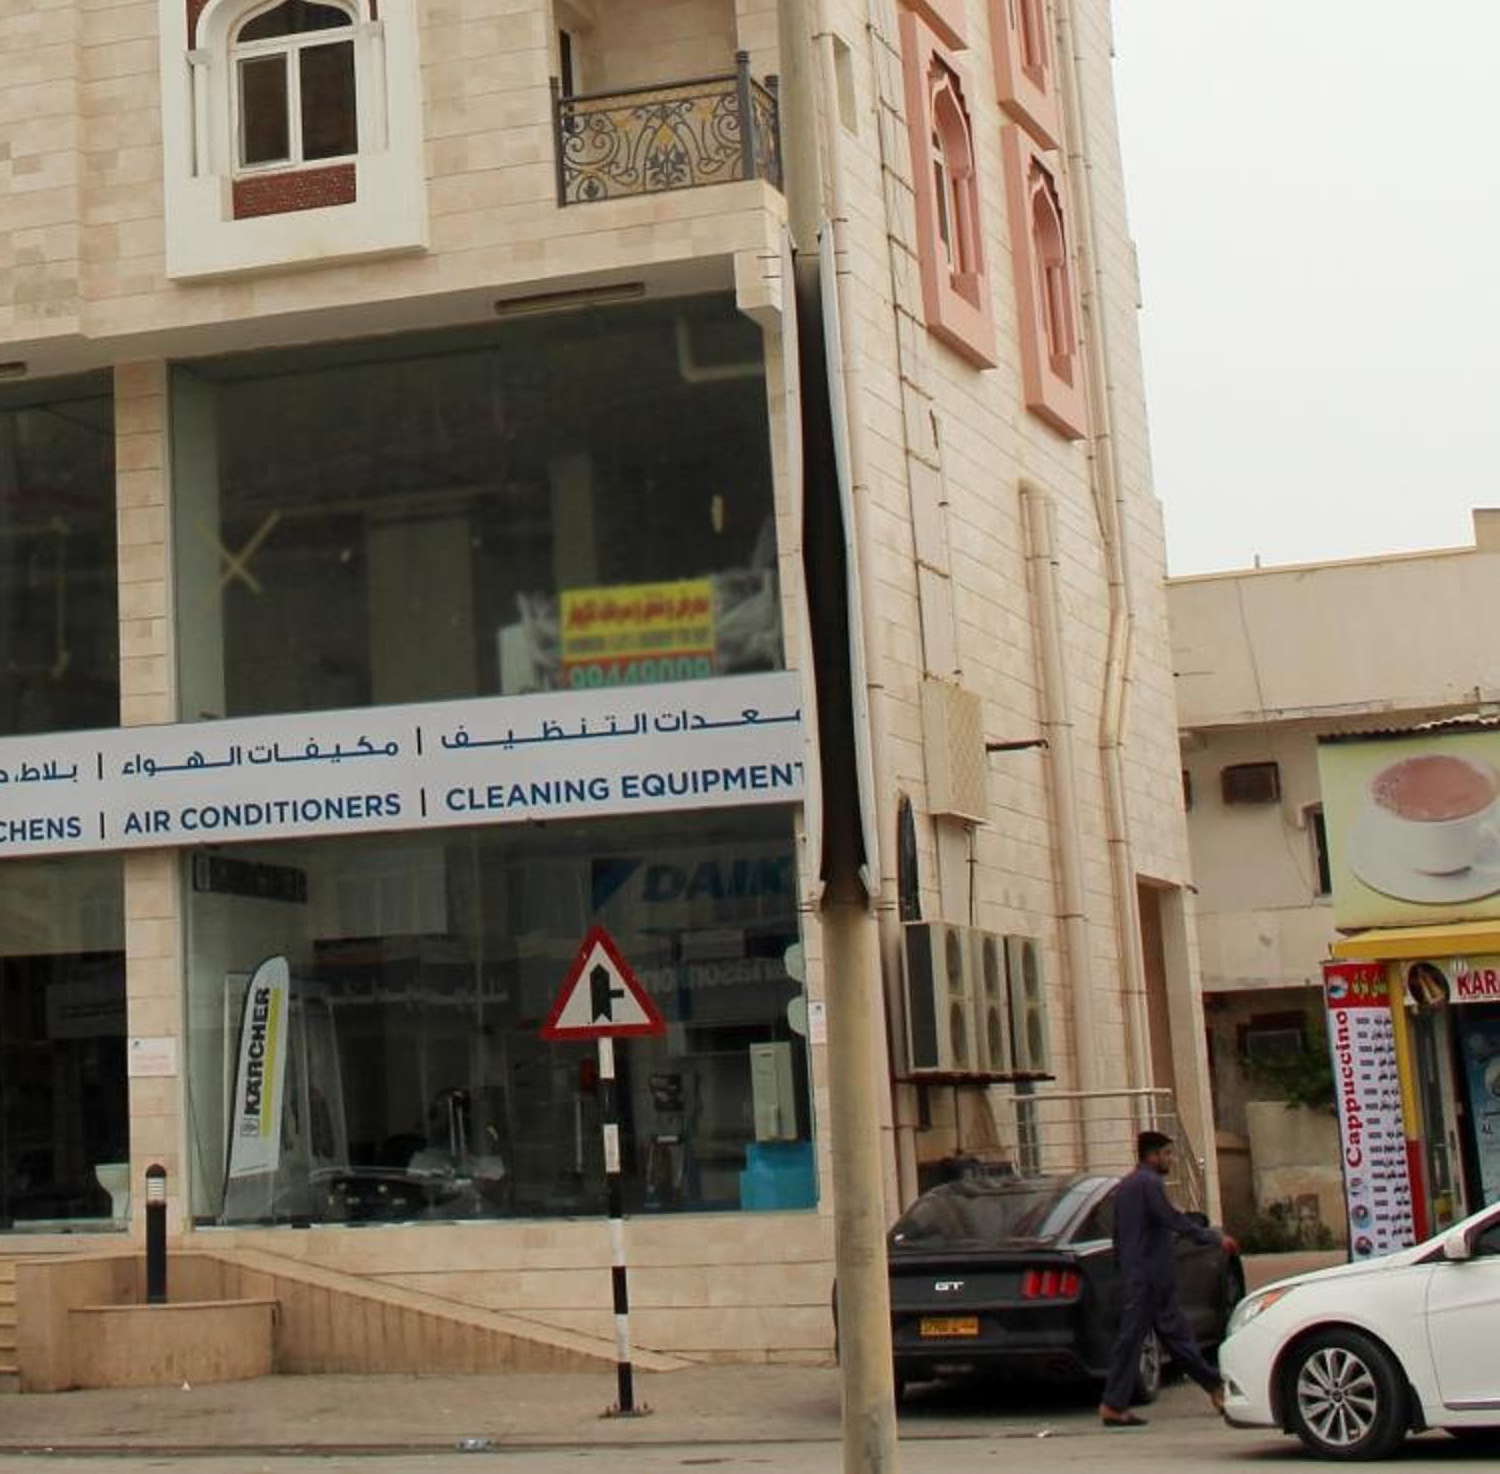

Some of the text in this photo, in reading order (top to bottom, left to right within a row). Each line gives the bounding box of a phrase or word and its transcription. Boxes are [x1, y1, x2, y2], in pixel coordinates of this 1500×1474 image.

[442, 712, 648, 750] التنظيف
[122, 736, 399, 776] مكيفات الهواء
[124, 793, 401, 834] AIR CONDITIONERS
[446, 778, 609, 811] CLEANING
[1456, 968, 1500, 998] KAR
[1335, 1011, 1364, 1169] Cappuccino
